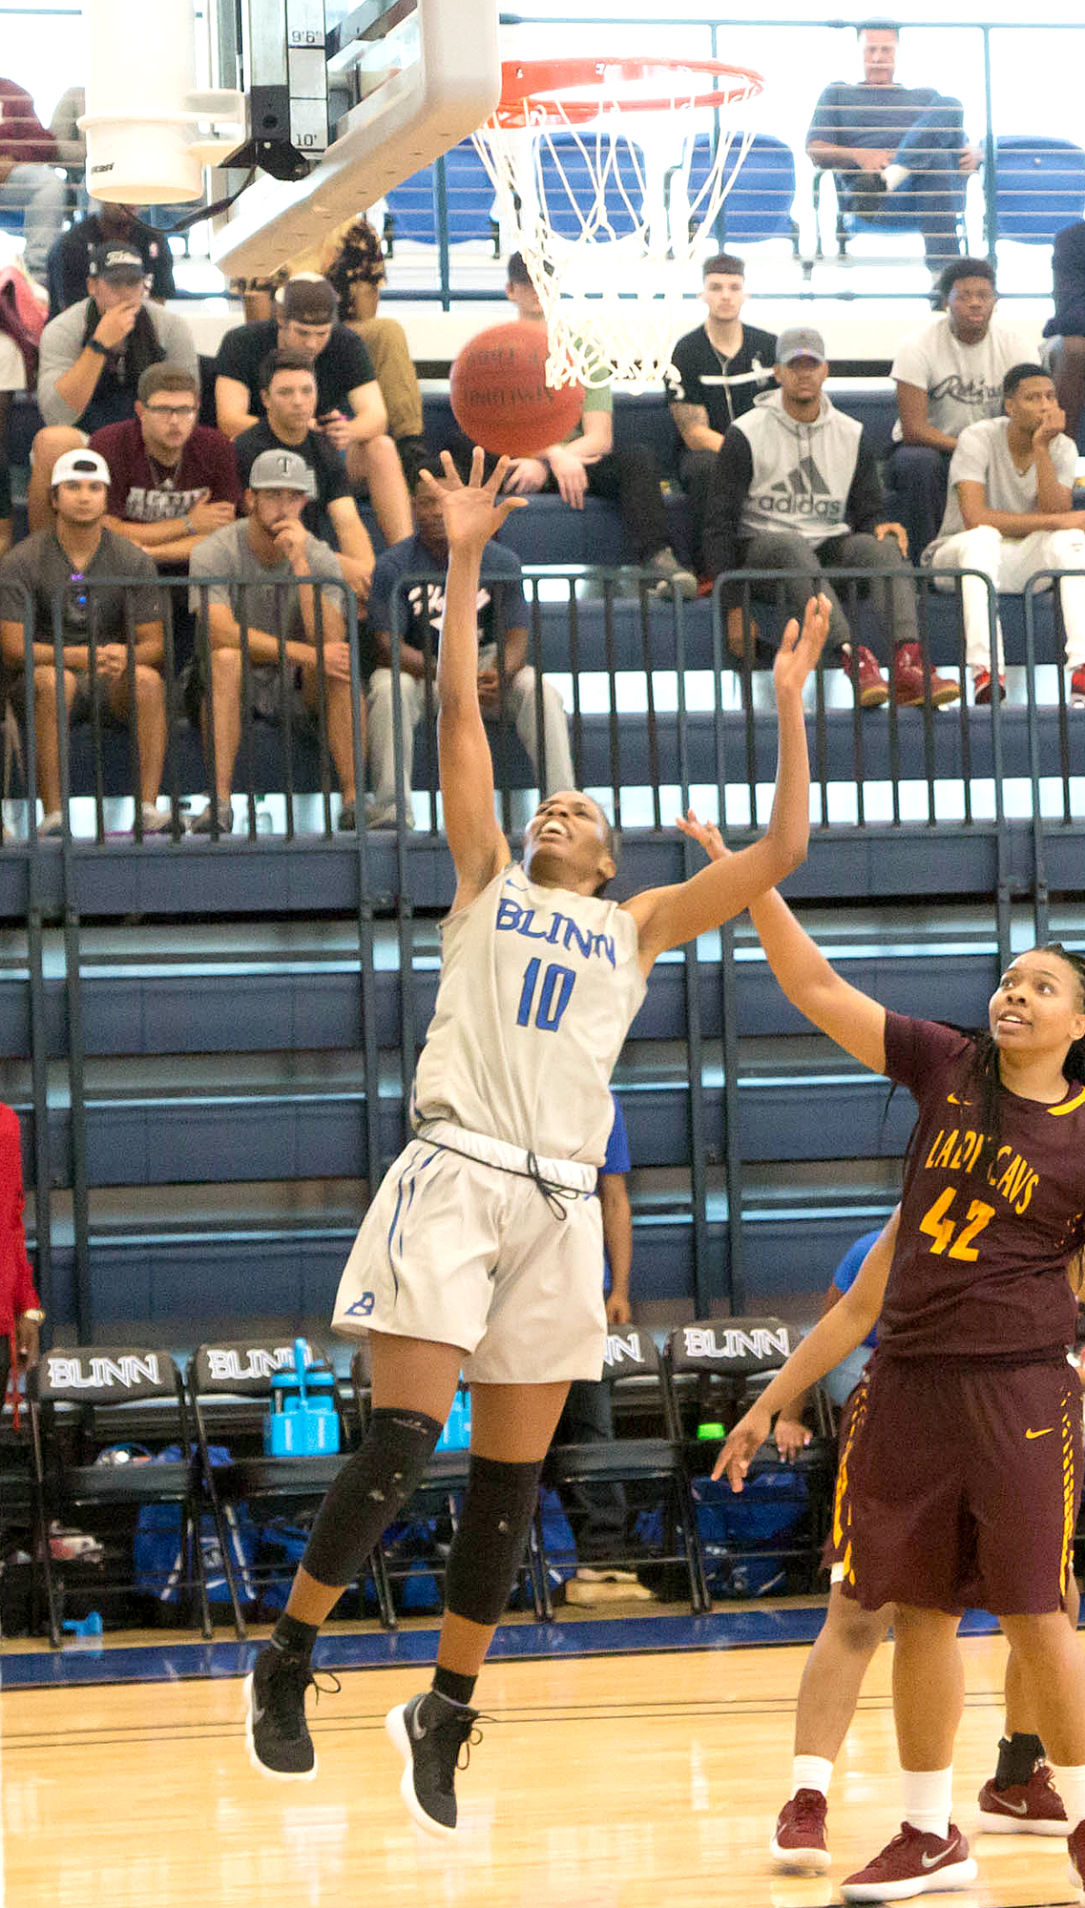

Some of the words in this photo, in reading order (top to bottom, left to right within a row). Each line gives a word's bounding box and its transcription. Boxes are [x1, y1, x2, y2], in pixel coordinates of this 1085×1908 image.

[296, 132, 317, 147] 10'
[759, 494, 841, 515] adidas
[496, 897, 616, 970] BLINN
[516, 957, 577, 1032] 10
[918, 1186, 996, 1262] 42
[683, 1327, 791, 1359] BLINN
[48, 1353, 162, 1388] BLINN
